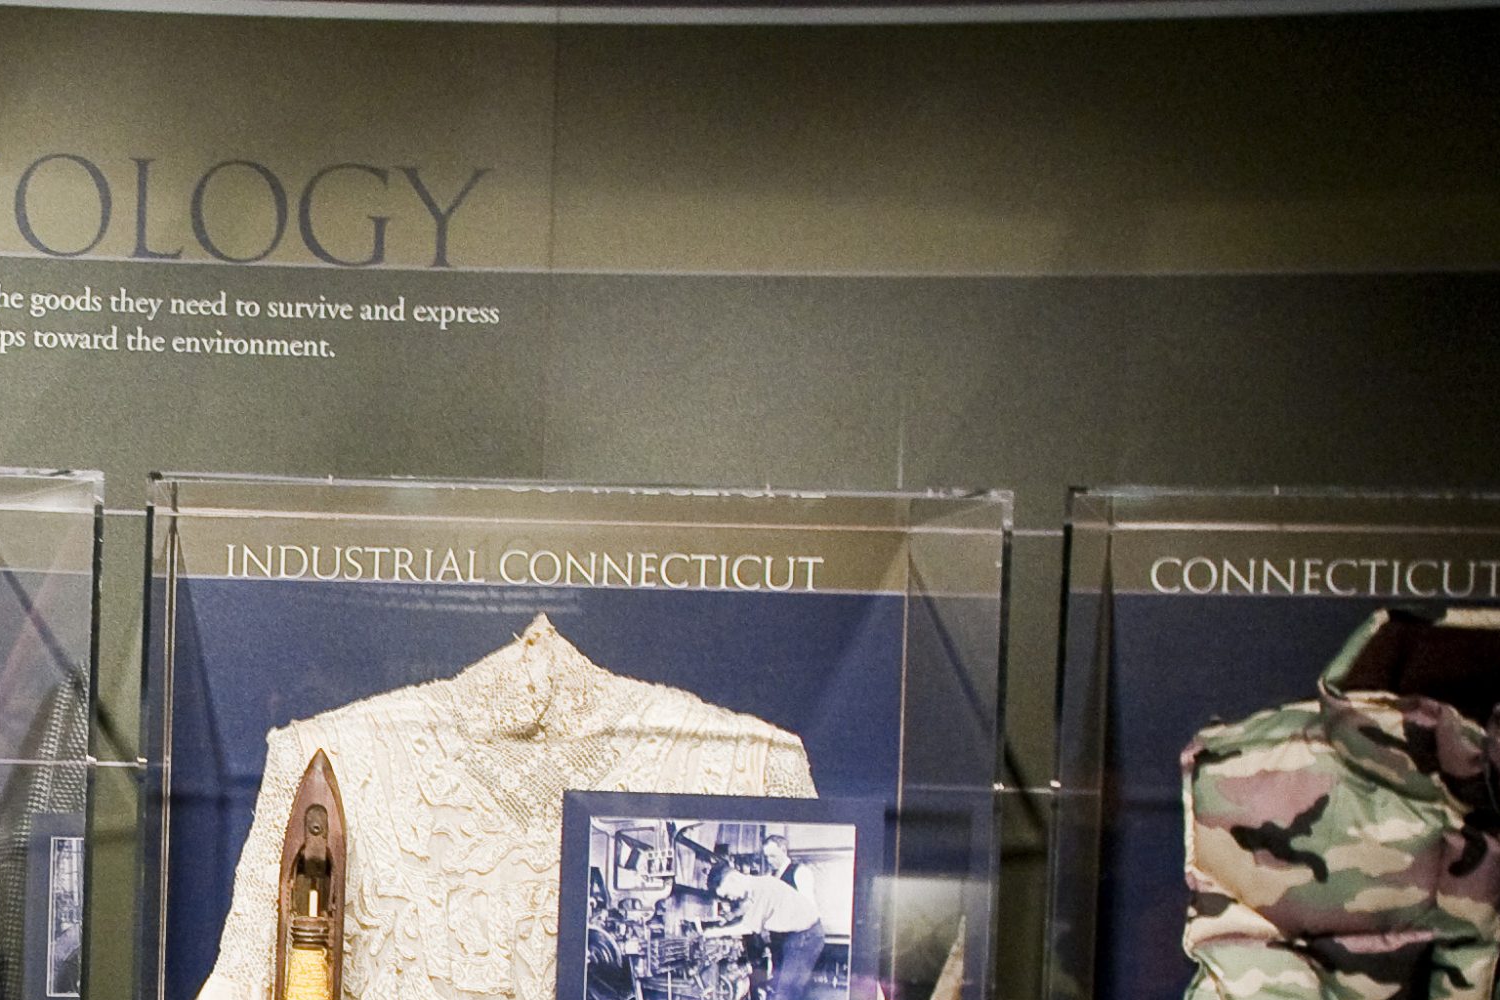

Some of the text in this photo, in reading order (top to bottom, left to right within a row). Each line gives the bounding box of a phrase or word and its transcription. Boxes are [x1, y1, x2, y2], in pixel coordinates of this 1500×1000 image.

[29, 285, 102, 317] goods
[109, 286, 163, 321] they
[170, 290, 228, 316] need
[235, 298, 260, 317] to
[267, 294, 353, 320] survive
[359, 295, 406, 321] and
[412, 305, 499, 330] express
[33, 324, 118, 350] toward
[126, 325, 165, 352] the
[171, 329, 335, 357] environment.
[225, 543, 824, 591] INDUSTRIAL CONNECTICUT
[1149, 556, 1500, 598] CONNECTICUT
